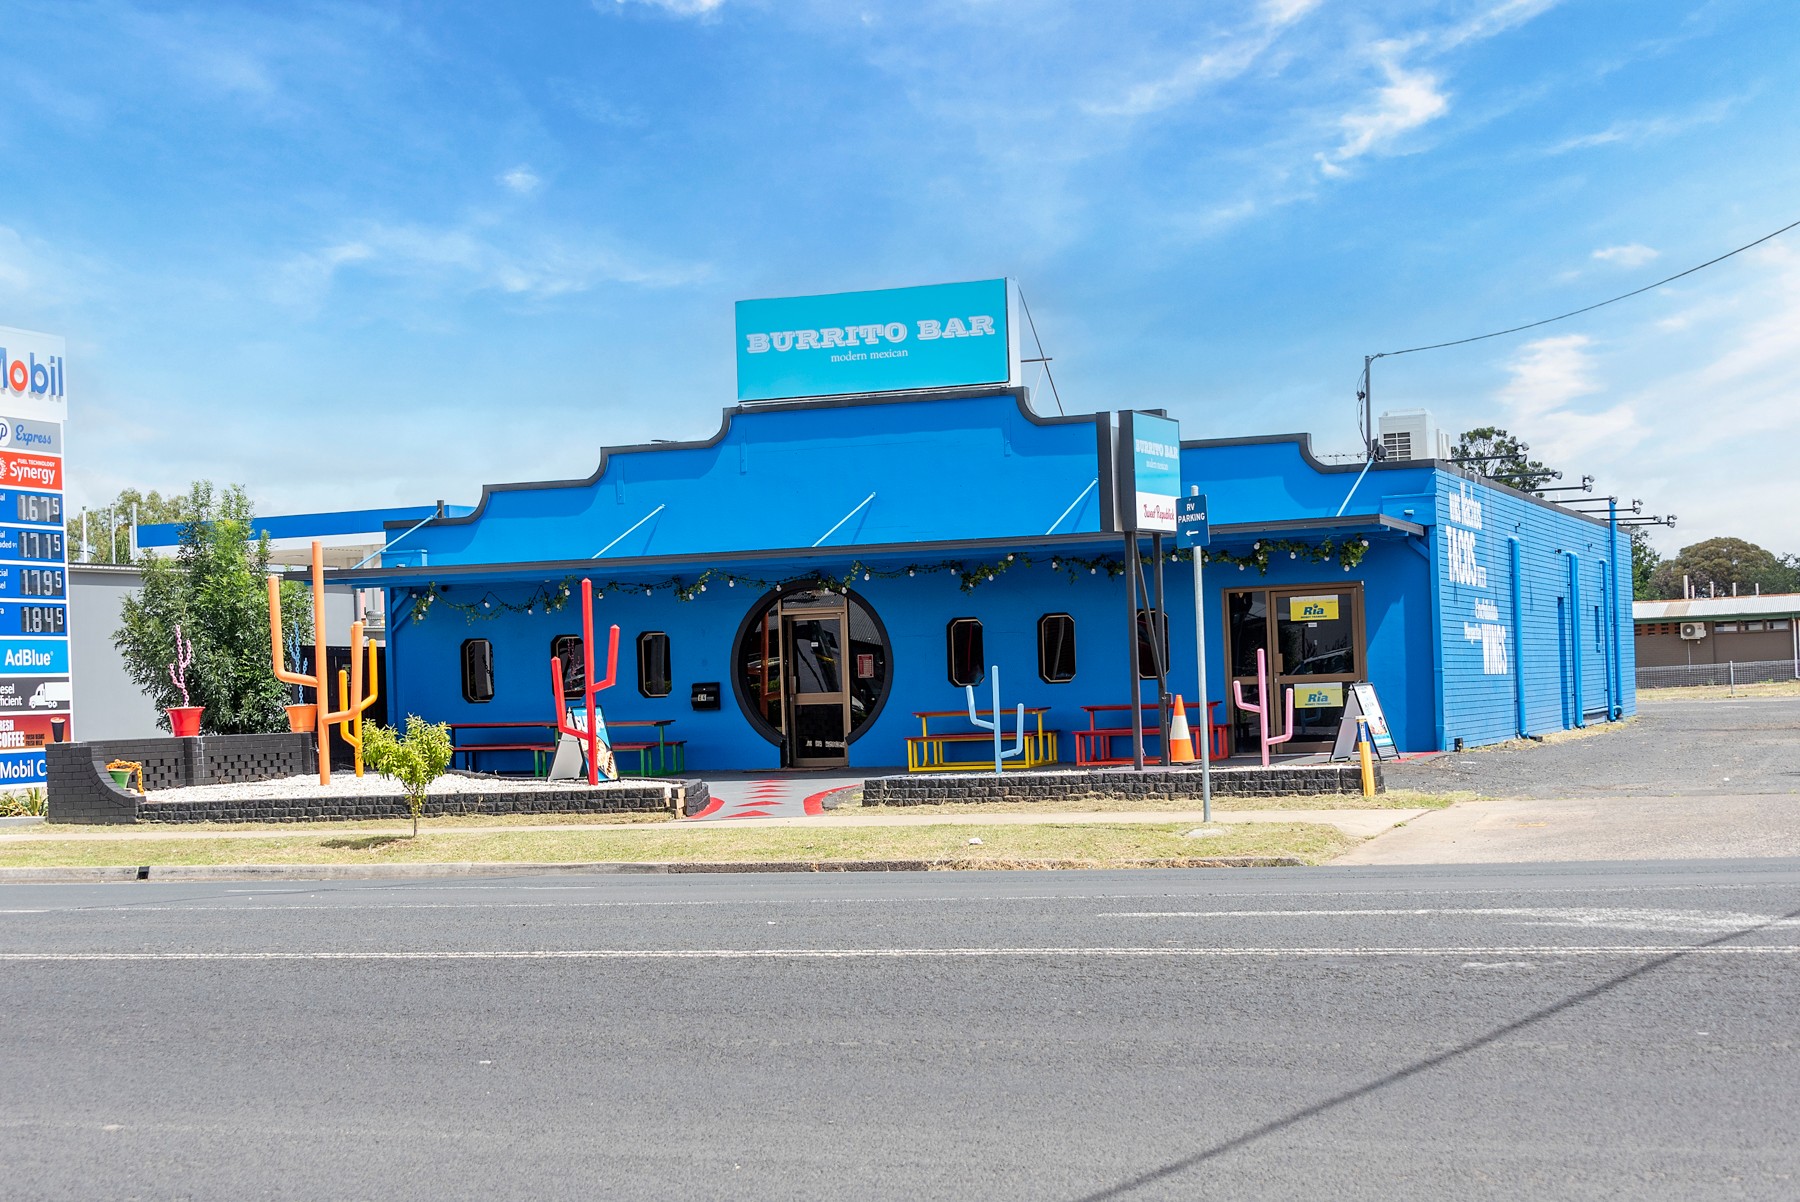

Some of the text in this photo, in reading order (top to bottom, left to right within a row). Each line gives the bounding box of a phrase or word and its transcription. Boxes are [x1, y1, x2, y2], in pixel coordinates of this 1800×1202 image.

[746, 315, 995, 353] BURRITO BAR
[831, 349, 908, 362] modern mexican
[15, 424, 52, 446] Express
[1135, 439, 1178, 460] BURRITO BAR
[9, 461, 55, 485] Synergy
[29, 460, 55, 468] TECHNOLOGY
[1186, 503, 1195, 511] RV
[1178, 513, 1205, 523] PARKING
[1446, 525, 1477, 587] TACOS
[1303, 603, 1325, 616] Ria
[1482, 623, 1507, 675] WINGS
[1308, 691, 1329, 703] Ria
[0, 759, 34, 779] Mobil
